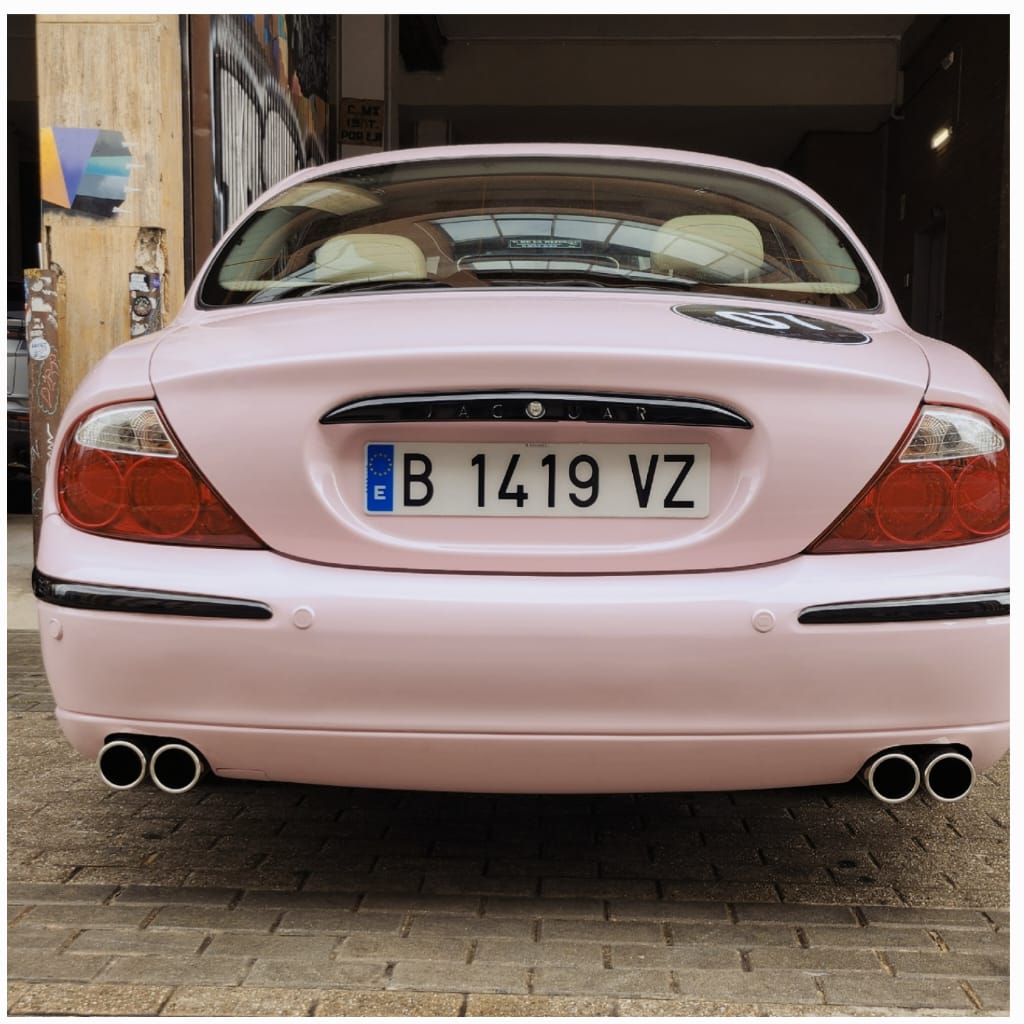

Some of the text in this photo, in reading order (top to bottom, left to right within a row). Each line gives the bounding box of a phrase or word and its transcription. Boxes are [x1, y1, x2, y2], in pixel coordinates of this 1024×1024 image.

[373, 485, 387, 500] E
[403, 453, 696, 508] B 1419 VZ
